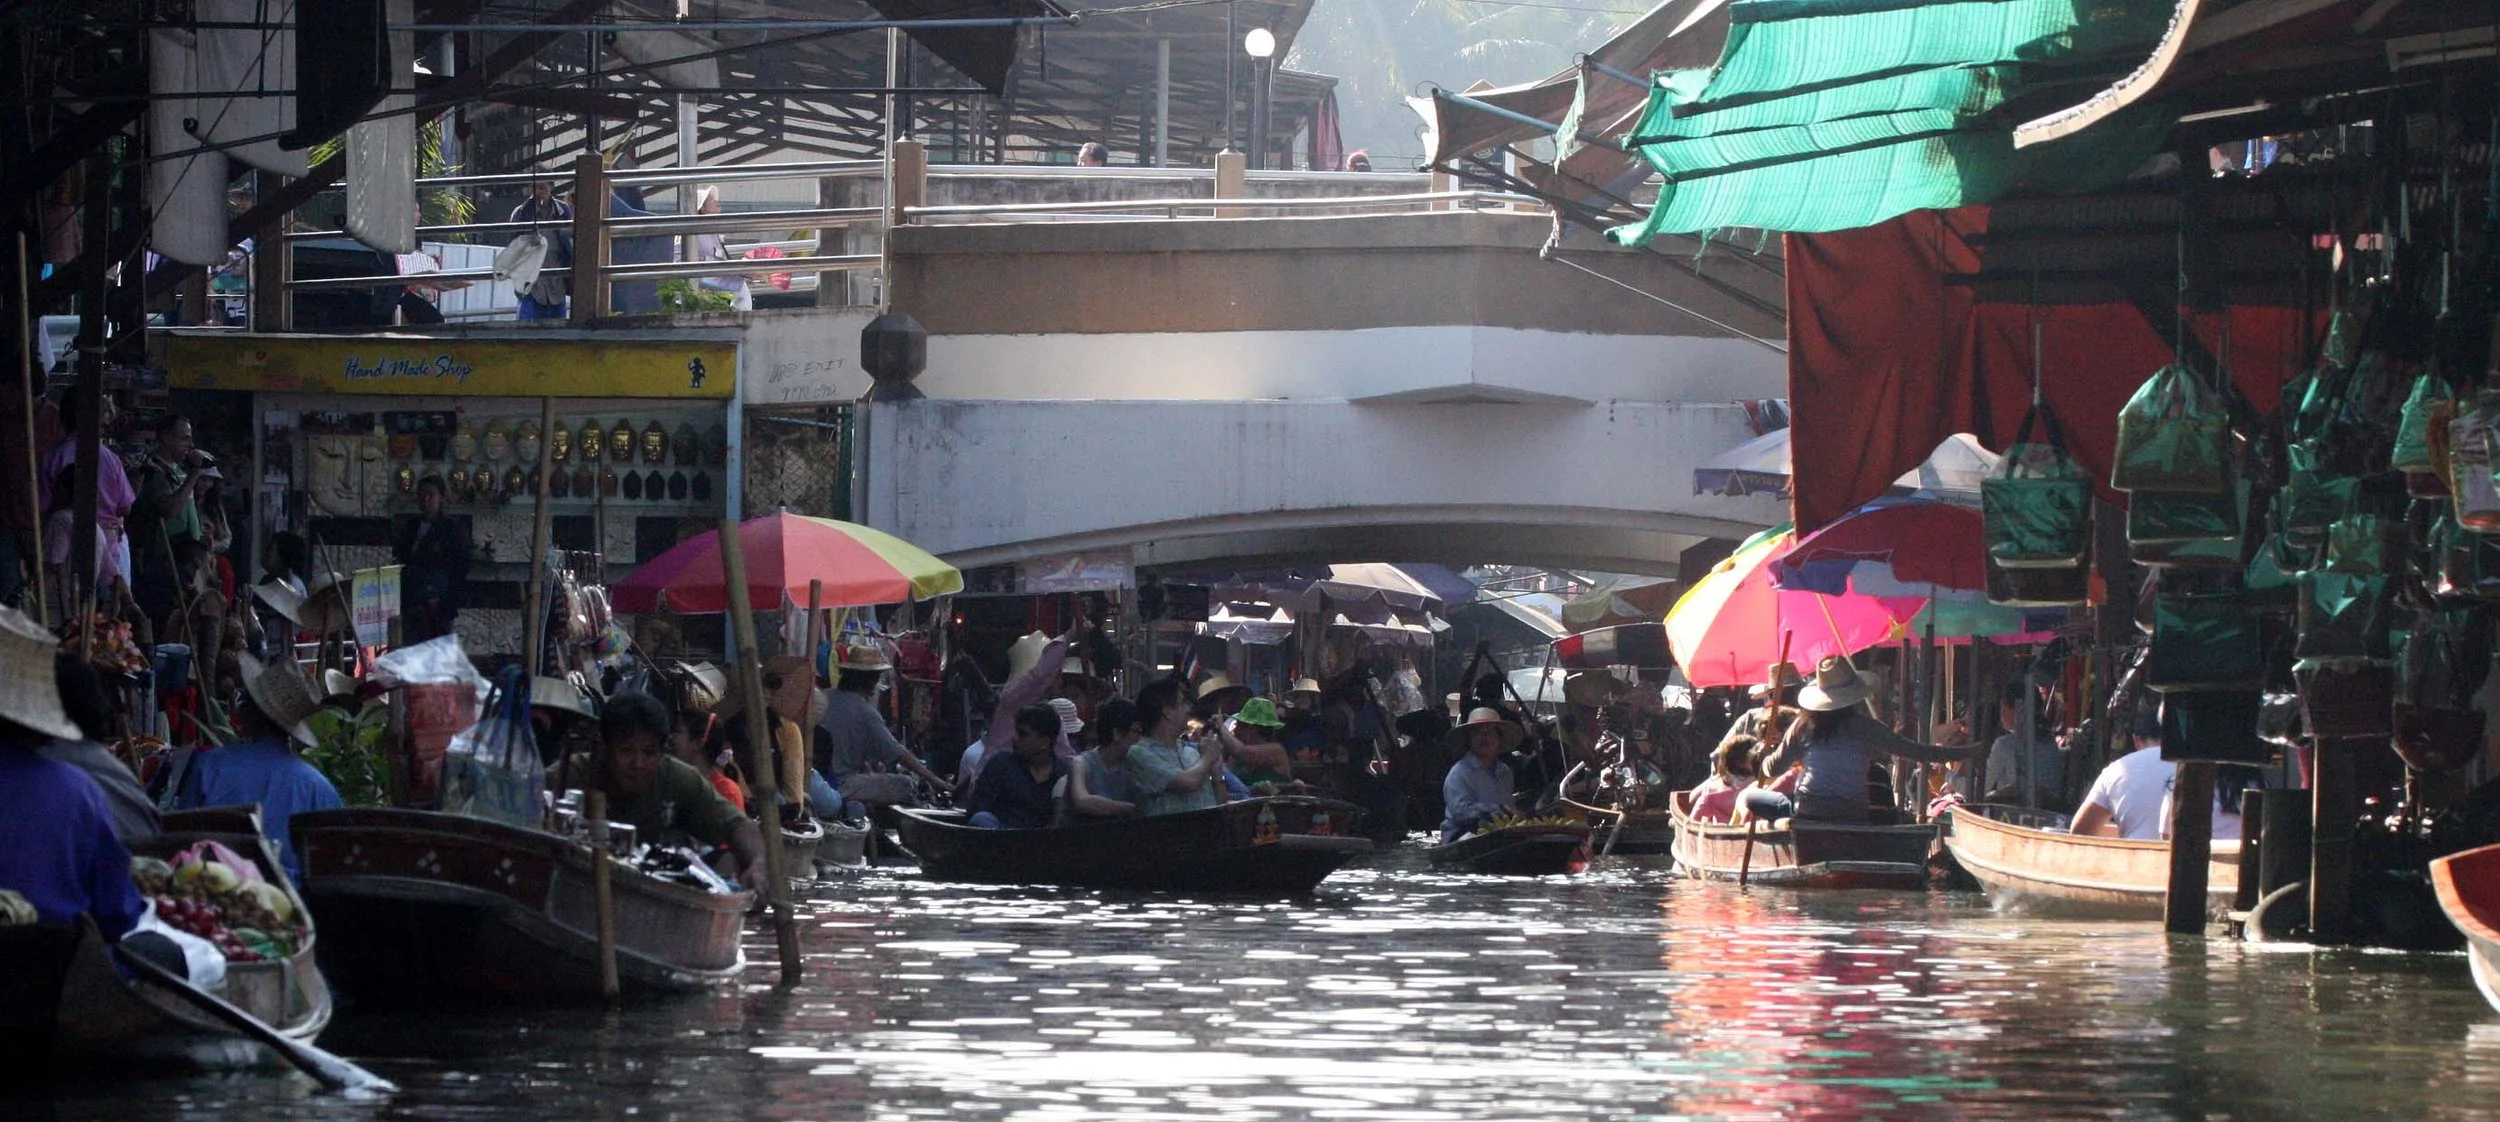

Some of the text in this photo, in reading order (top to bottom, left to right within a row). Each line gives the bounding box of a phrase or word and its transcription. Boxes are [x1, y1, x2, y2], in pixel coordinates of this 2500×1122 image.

[345, 355, 472, 382] Hand Made Shop
